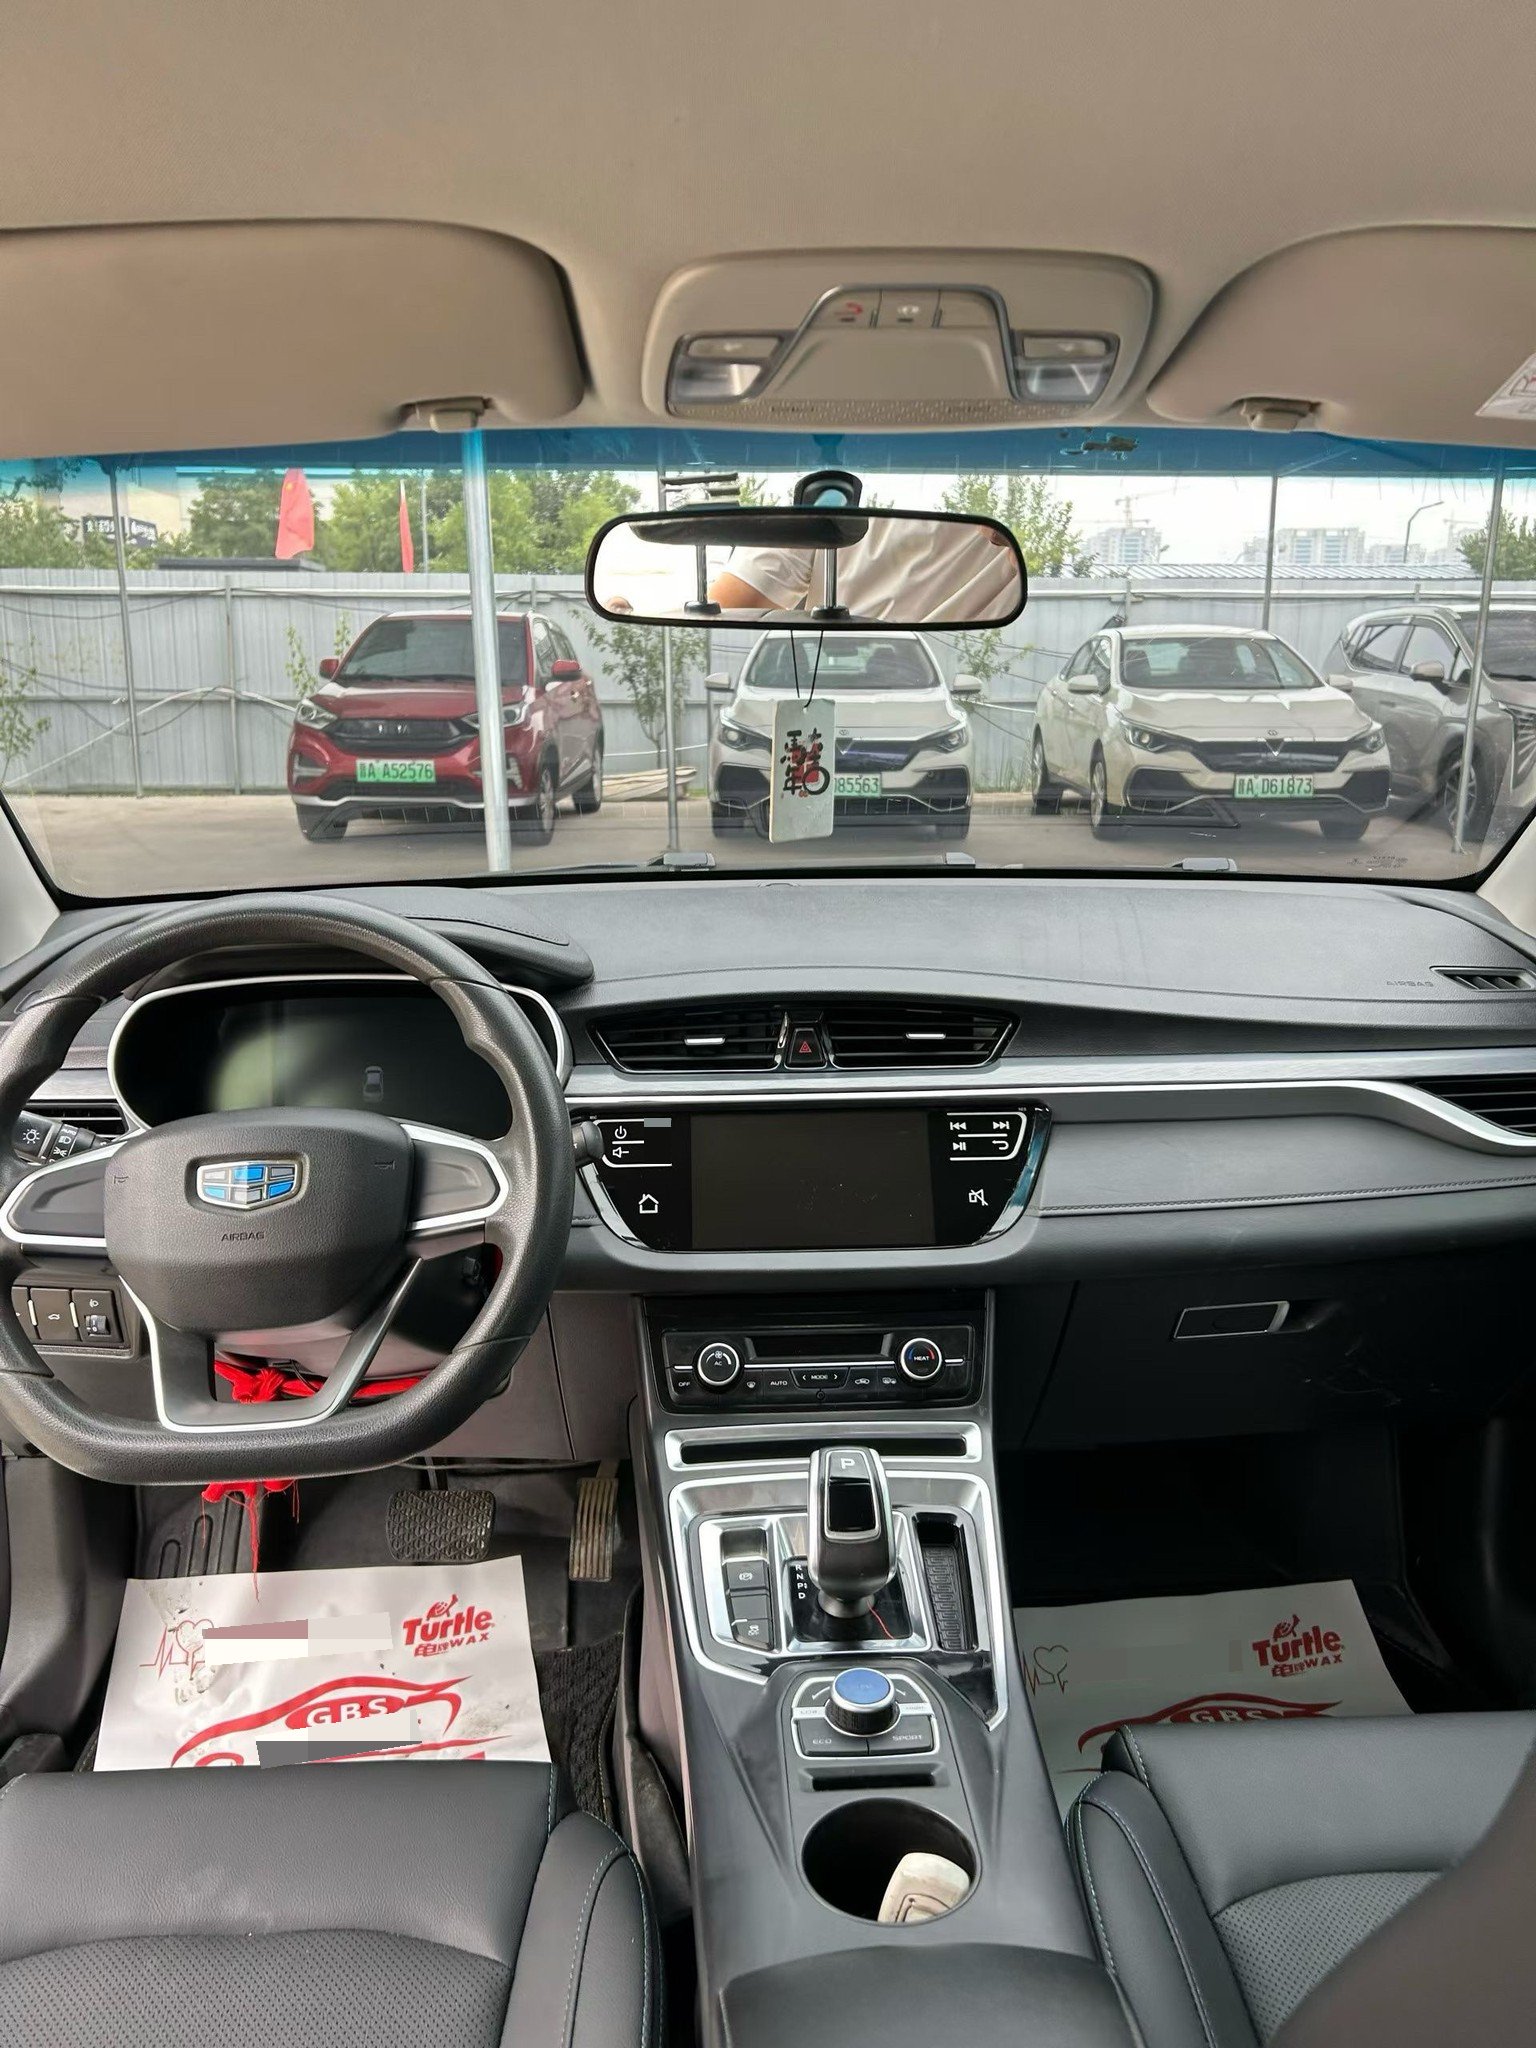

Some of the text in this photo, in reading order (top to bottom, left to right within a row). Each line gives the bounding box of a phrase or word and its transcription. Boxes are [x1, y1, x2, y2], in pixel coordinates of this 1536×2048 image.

[383, 763, 433, 779] A52576
[1262, 778, 1312, 794] D61873
[221, 1231, 265, 1242] AIRBAG
[840, 1458, 856, 1469] P
[403, 1606, 492, 1645] Turtle
[449, 1632, 489, 1648] WAX
[1252, 1625, 1341, 1666] Turtle
[1304, 1654, 1342, 1668] WAX
[307, 1698, 388, 1727] GBS
